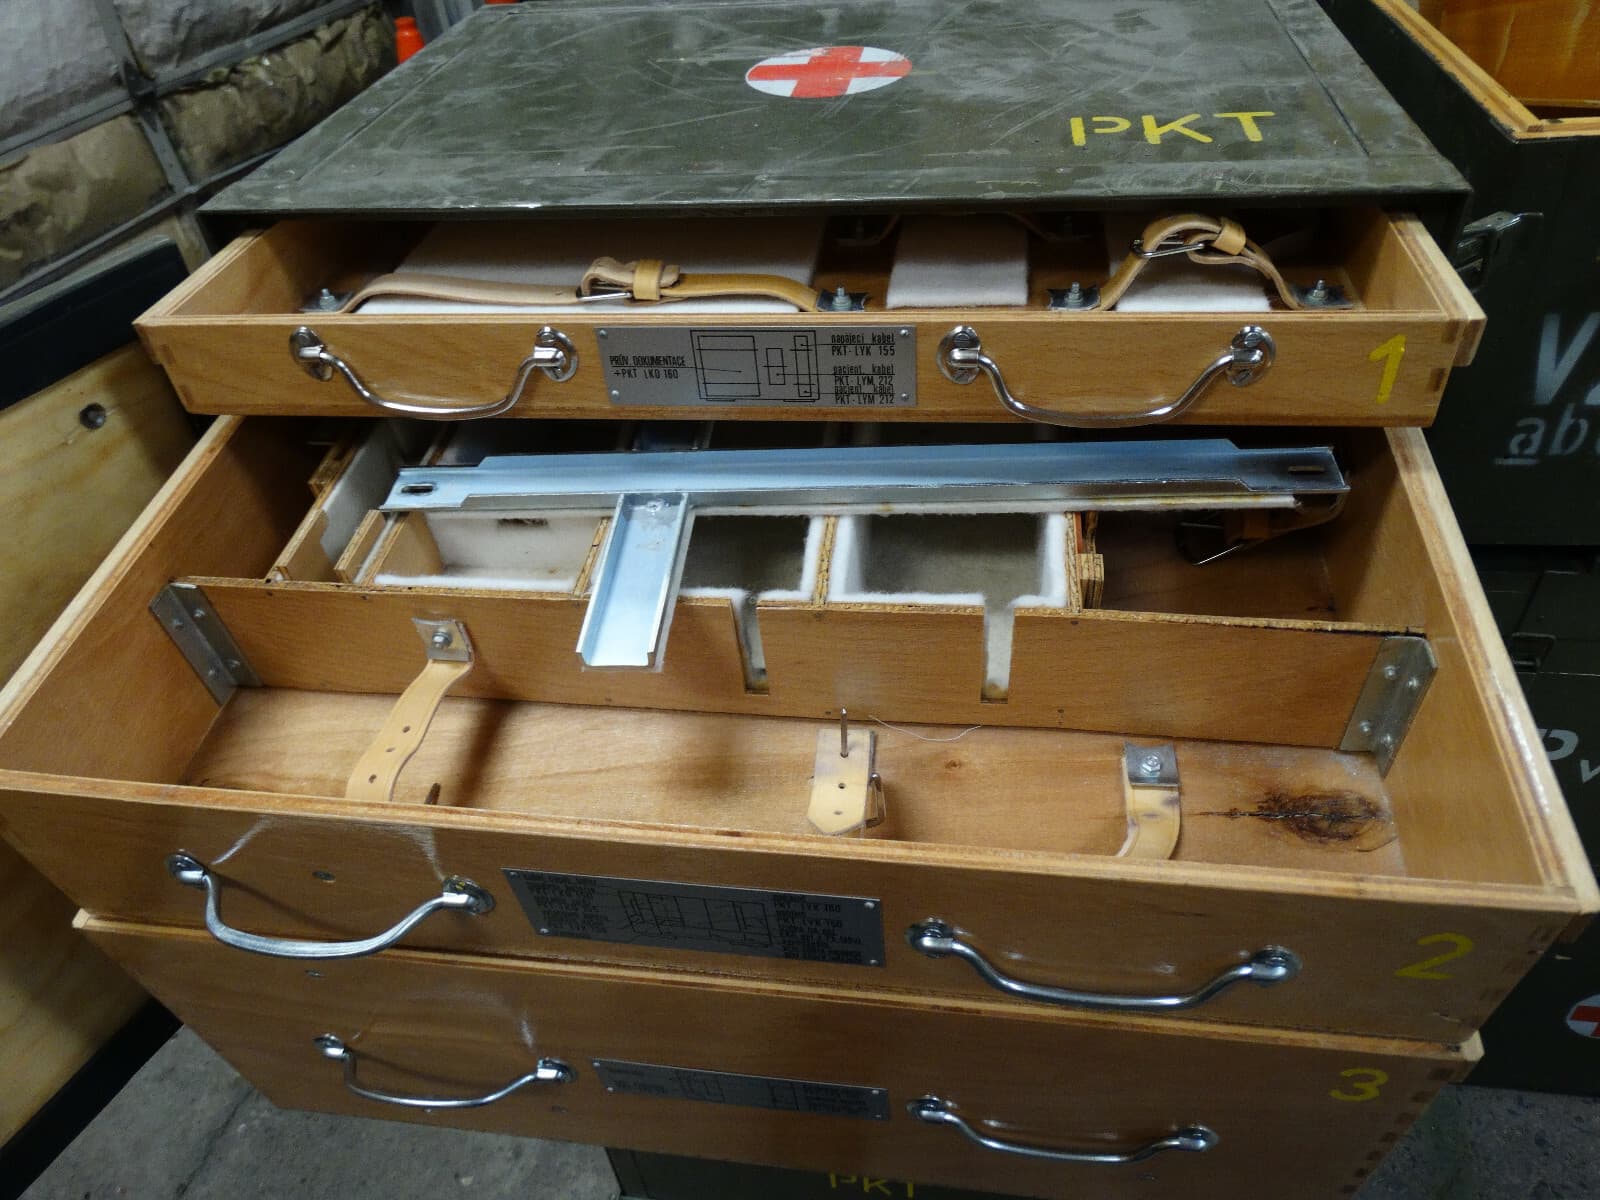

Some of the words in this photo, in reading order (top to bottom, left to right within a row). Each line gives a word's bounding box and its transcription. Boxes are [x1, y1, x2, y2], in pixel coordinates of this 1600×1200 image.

[1070, 111, 1276, 146] PKT
[872, 332, 895, 344] kabel
[880, 345, 896, 356] 155
[872, 363, 894, 374] kabel
[1368, 334, 1406, 405] 1
[879, 375, 893, 386] 212
[880, 394, 895, 404] 212
[1394, 932, 1474, 980] 2
[1328, 1068, 1390, 1102] 3
